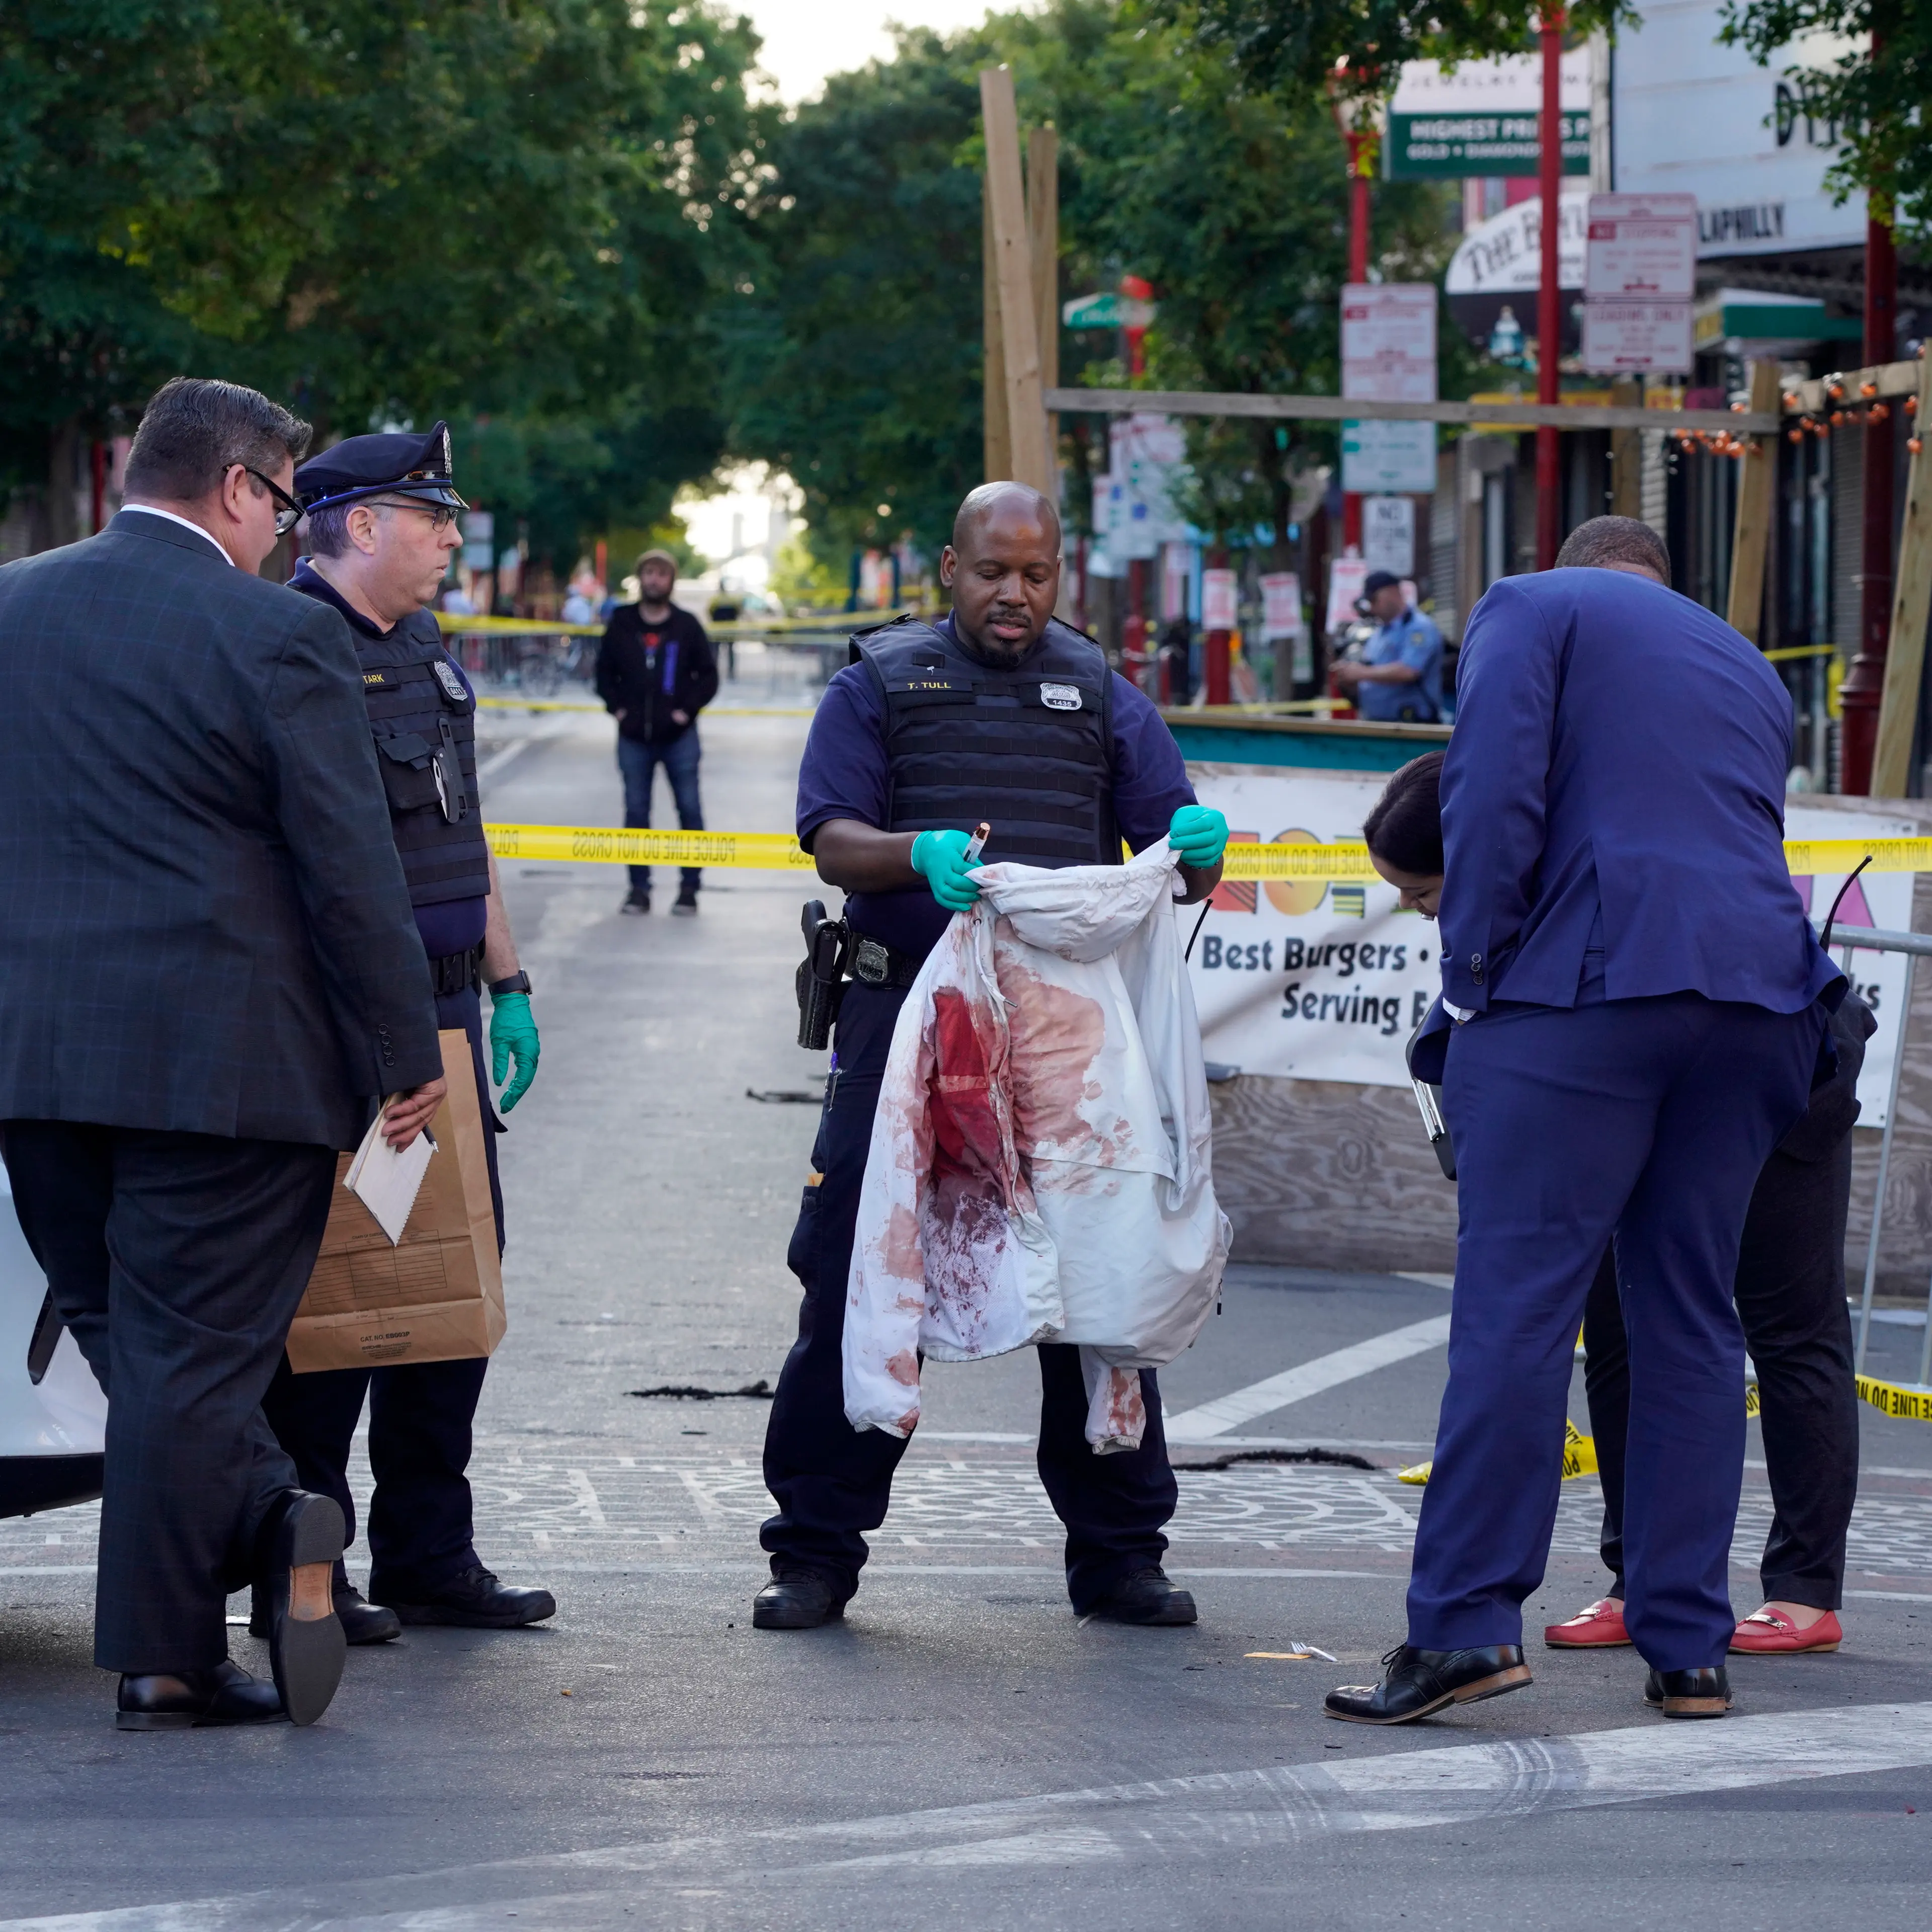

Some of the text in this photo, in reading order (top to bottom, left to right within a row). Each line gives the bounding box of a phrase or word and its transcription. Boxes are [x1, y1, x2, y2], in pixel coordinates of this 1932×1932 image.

[1410, 118, 1498, 141] HIGHEST
[1501, 118, 1573, 140] PRIS
[1407, 143, 1450, 160] GOLD
[1053, 699, 1072, 707] 1435
[1202, 935, 1407, 978] Best Burgers
[1281, 982, 1400, 1036] Serving
[1872, 1386, 1888, 1412] DO
[1892, 1391, 1918, 1417] LINE
